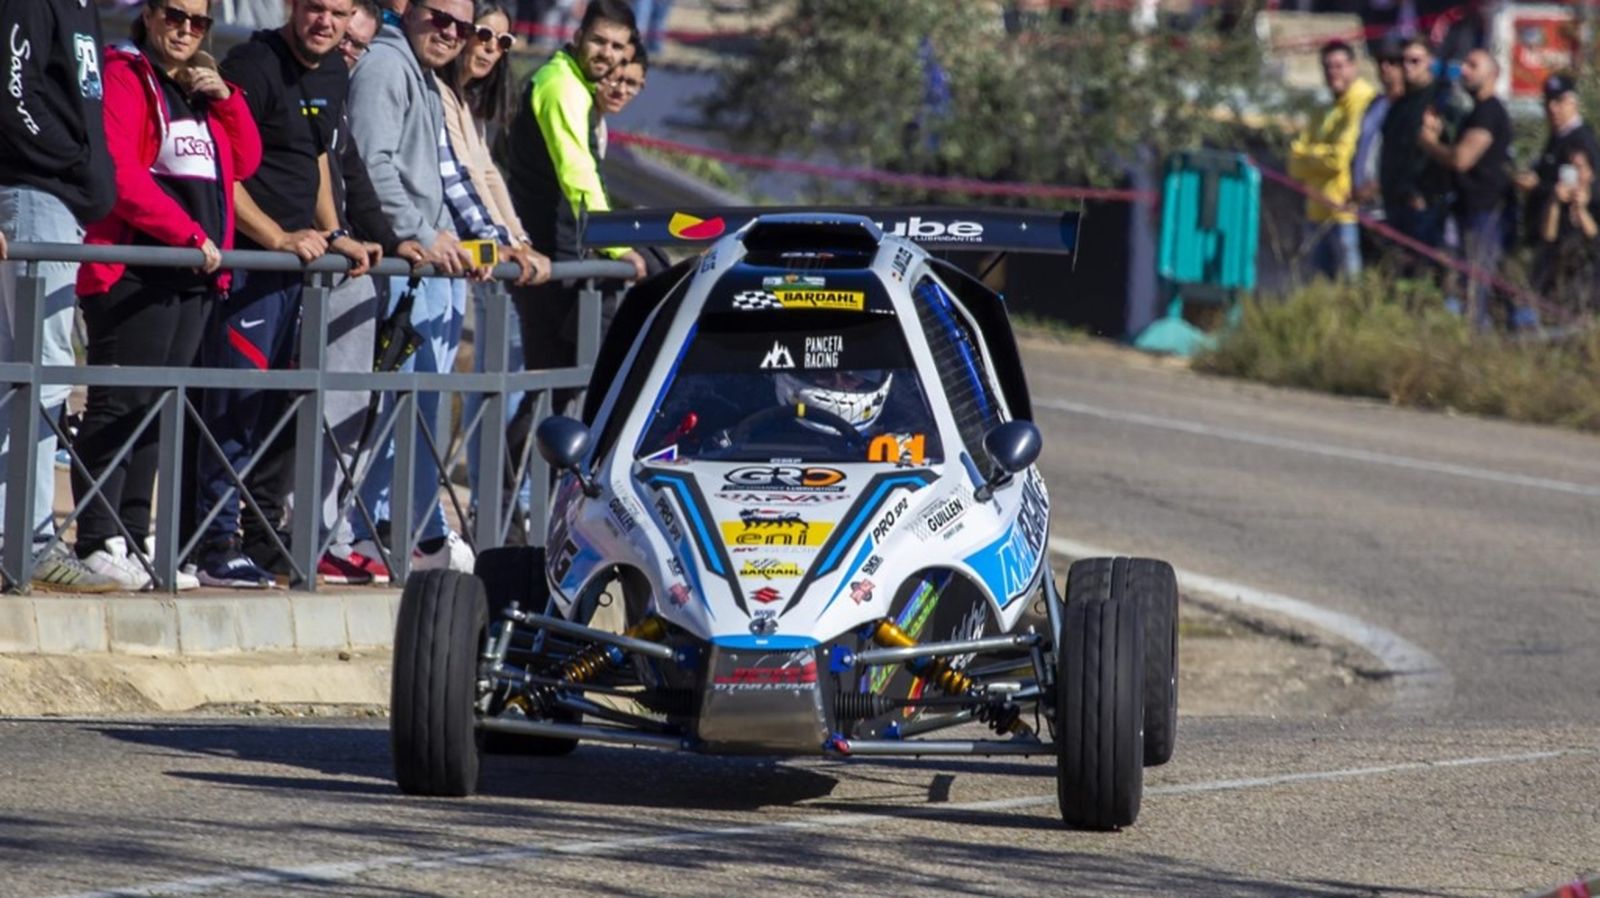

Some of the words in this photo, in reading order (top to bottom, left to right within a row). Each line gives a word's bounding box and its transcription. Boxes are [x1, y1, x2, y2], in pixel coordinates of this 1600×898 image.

[8, 23, 31, 98] Saxo
[783, 292, 857, 305] BARDAHL
[805, 335, 843, 352] PANCETA
[804, 352, 839, 368] RACING
[725, 465, 847, 487] GRO
[609, 498, 636, 533] GUILLEN
[927, 498, 964, 532] GUILLEN
[872, 510, 895, 544] PRO
[736, 530, 808, 545] eni
[739, 569, 802, 580] BARDAHL
